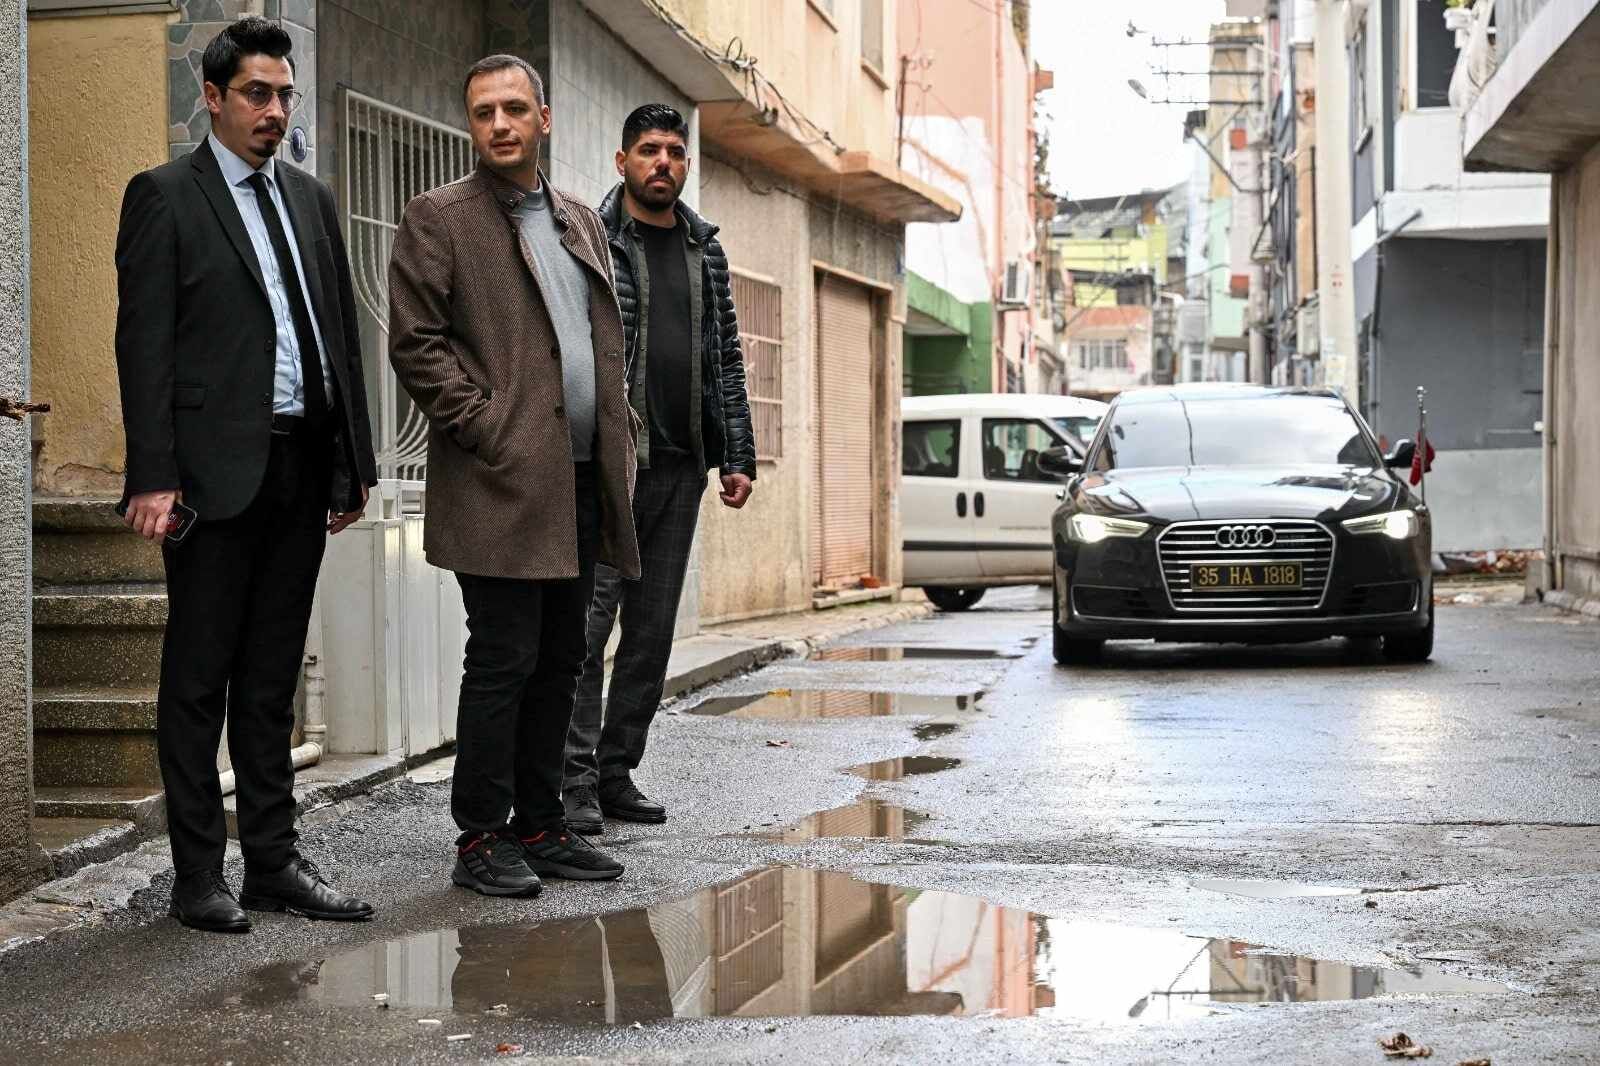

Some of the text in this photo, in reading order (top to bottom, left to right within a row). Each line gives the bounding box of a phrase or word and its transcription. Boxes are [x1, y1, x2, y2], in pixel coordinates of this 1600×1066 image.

[1199, 565, 1295, 585] 35 HA 1818
